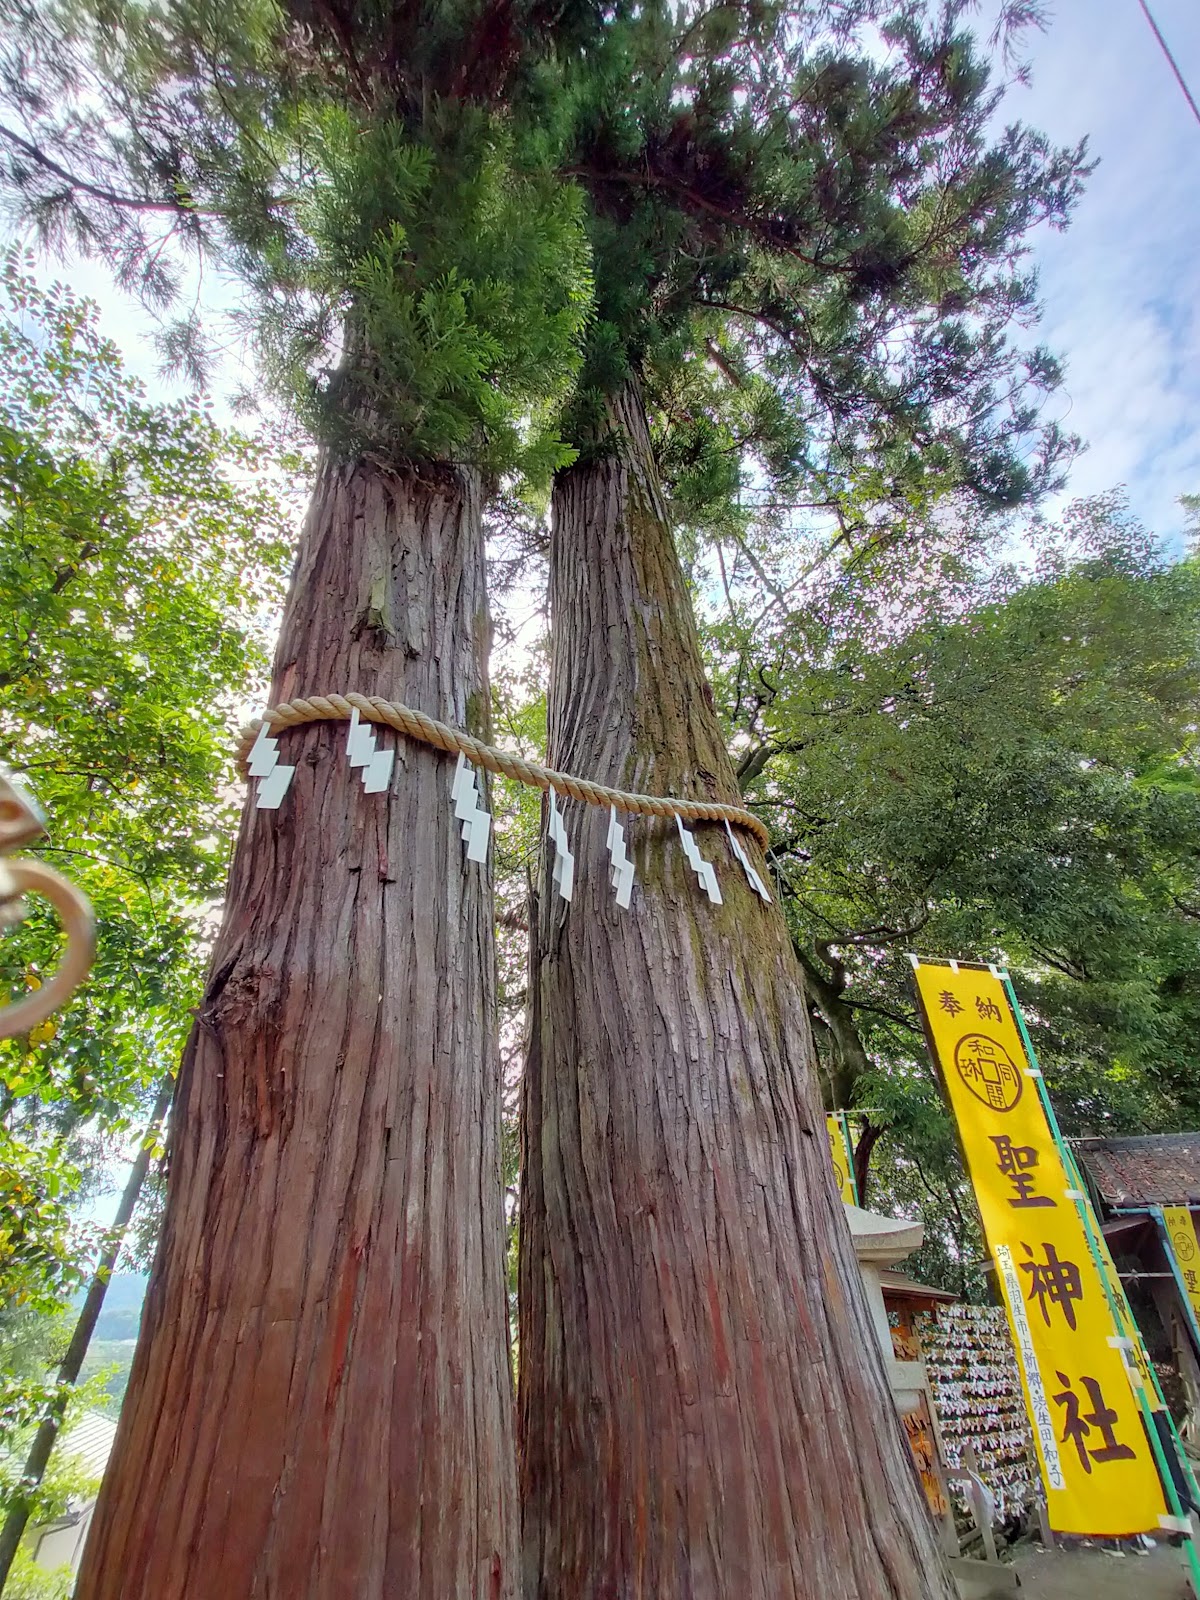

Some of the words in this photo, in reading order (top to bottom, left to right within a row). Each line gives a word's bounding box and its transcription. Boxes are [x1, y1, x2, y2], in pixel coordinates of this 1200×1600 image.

[939, 990, 1003, 1023] 奉納
[988, 1134, 1136, 1474] 聖神社
